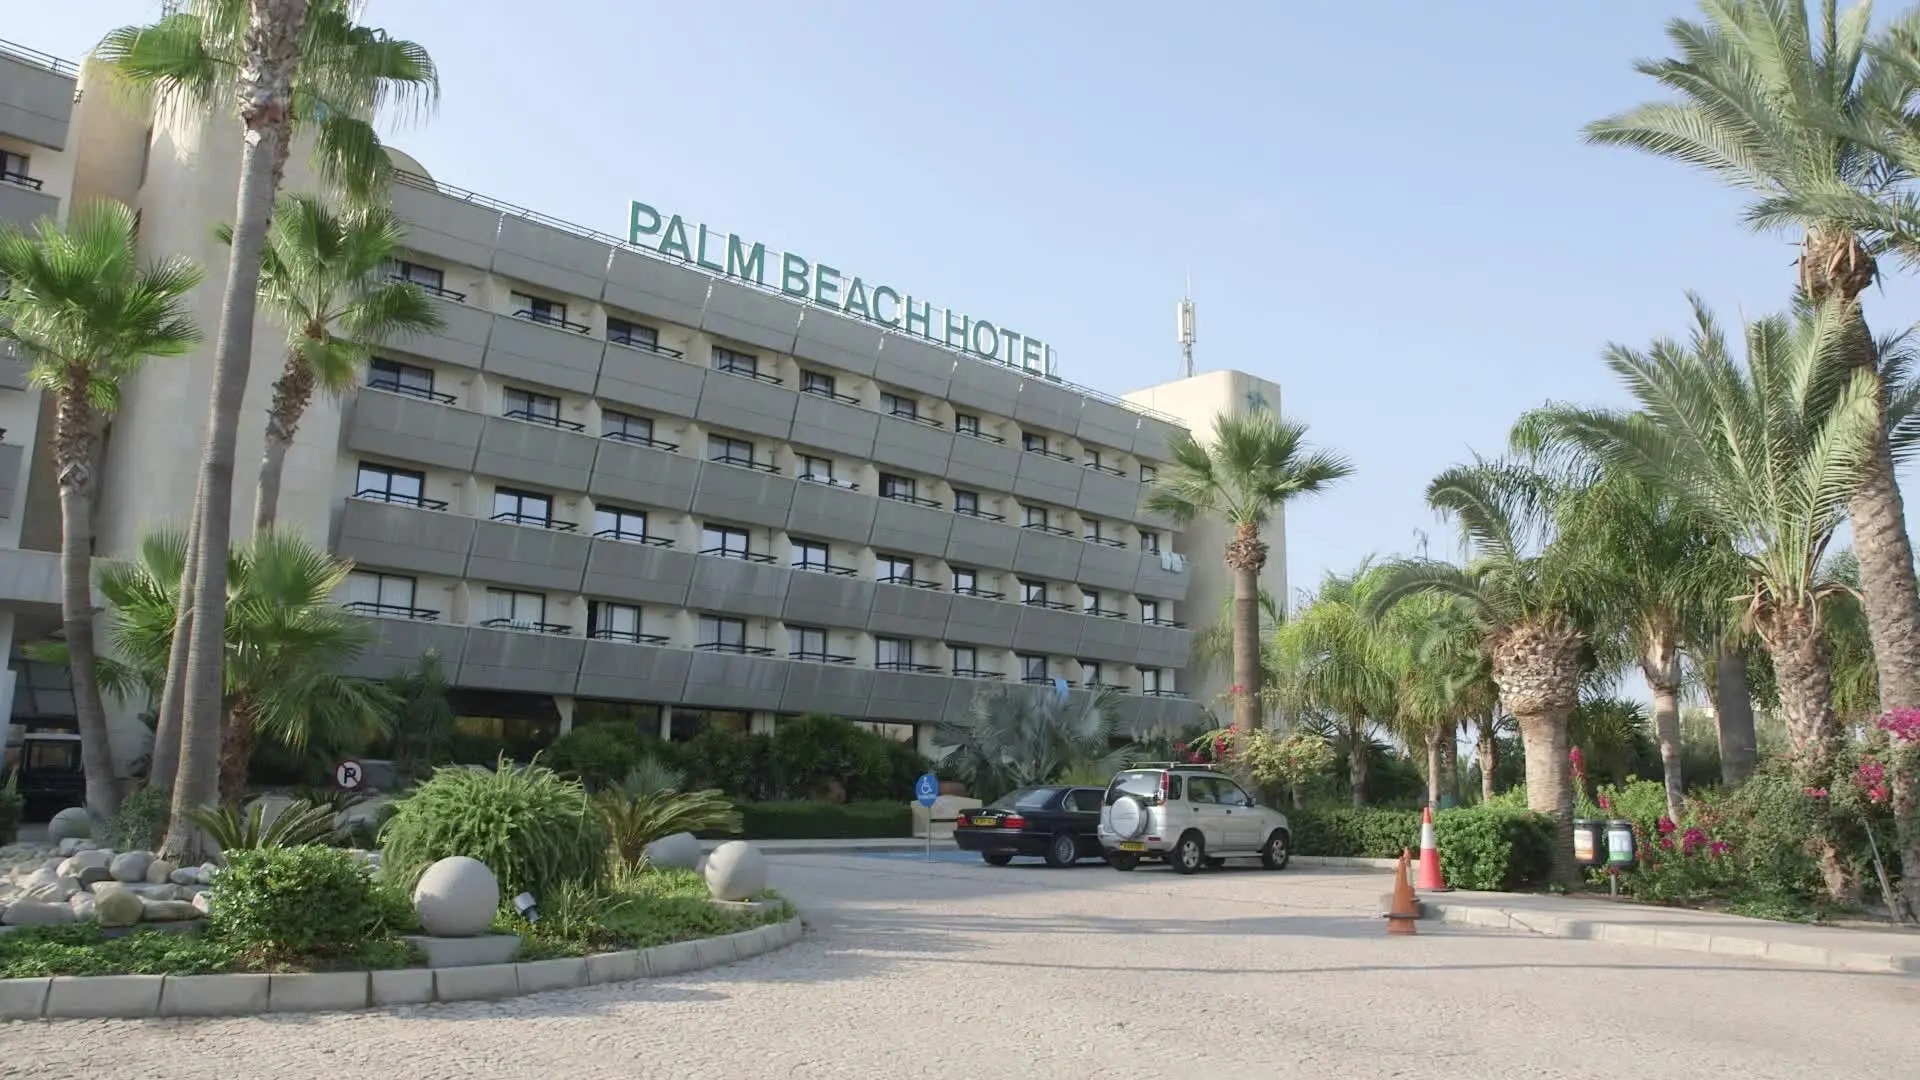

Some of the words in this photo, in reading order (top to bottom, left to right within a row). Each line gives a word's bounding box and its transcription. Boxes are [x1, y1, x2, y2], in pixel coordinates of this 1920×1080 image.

[628, 200, 766, 286] PALM
[780, 250, 931, 339] BEACH
[942, 307, 1062, 383] HOTEL
